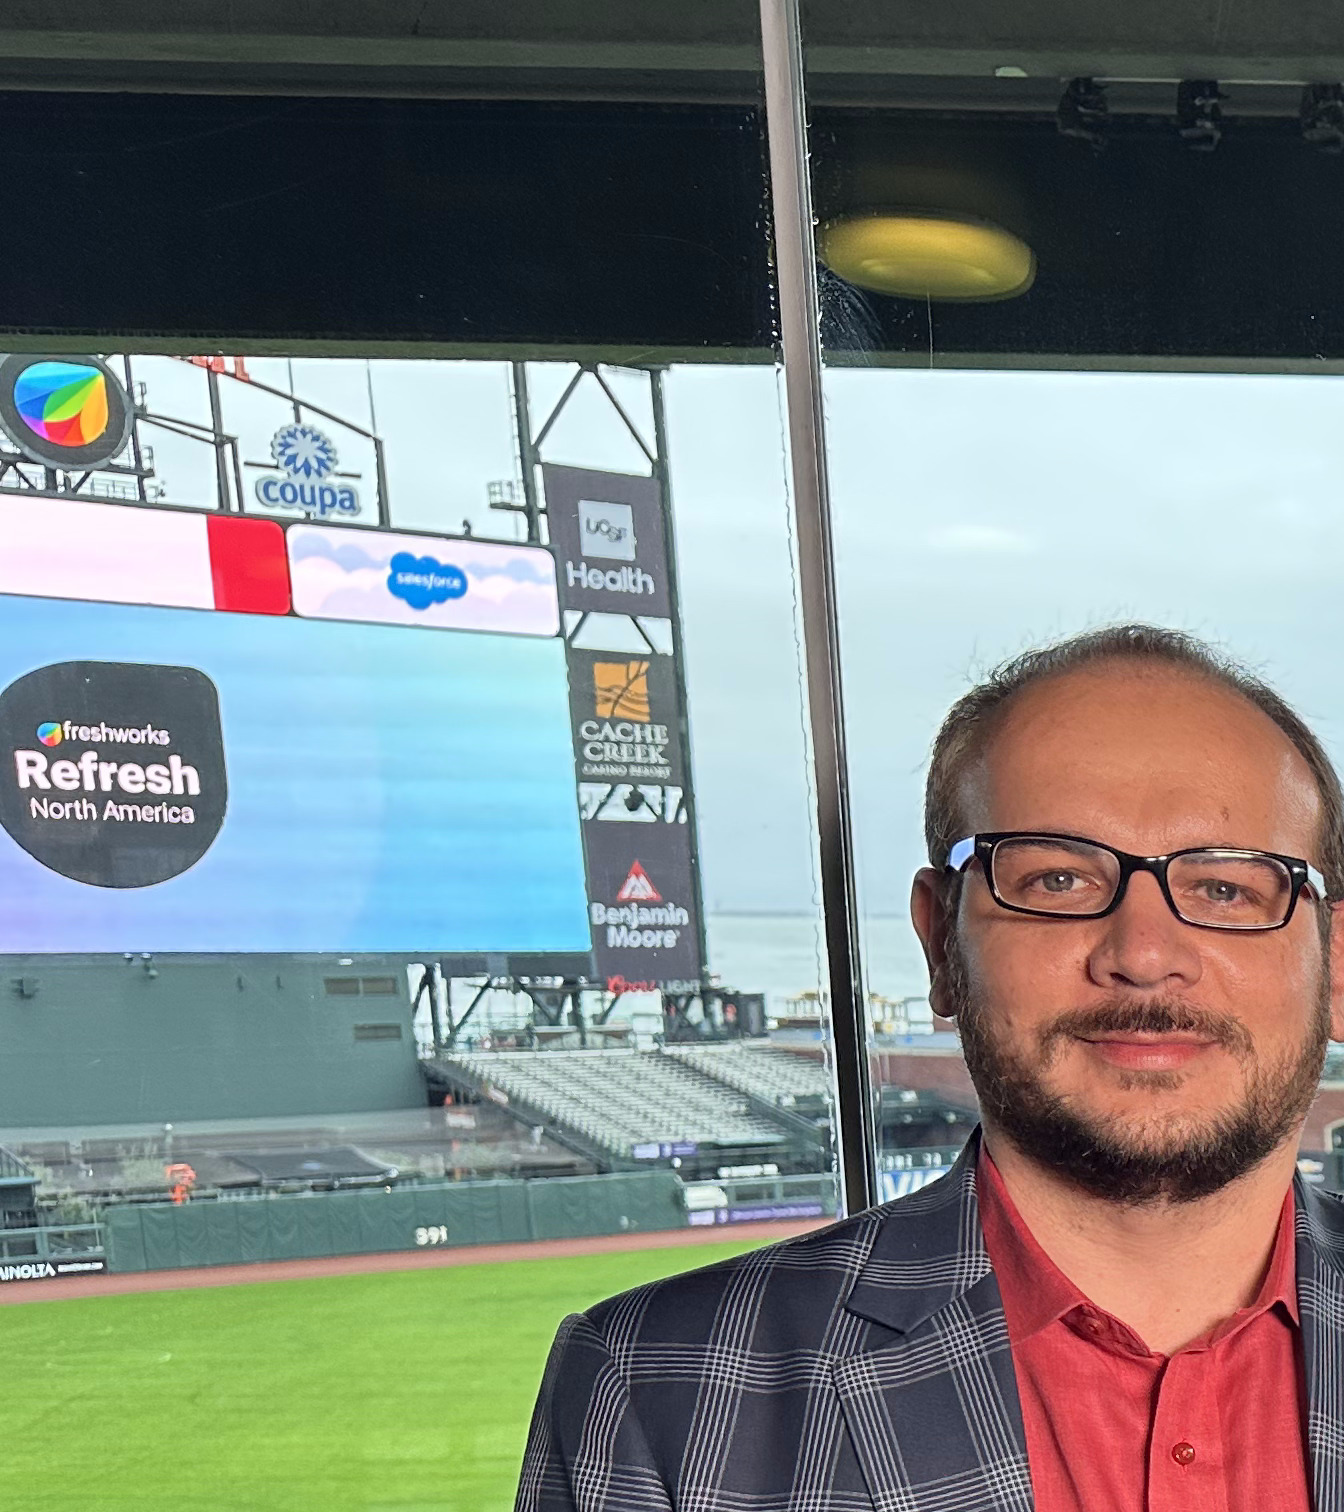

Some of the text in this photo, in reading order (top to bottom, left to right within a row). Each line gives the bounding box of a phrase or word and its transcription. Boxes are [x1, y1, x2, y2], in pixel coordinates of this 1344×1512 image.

[263, 479, 356, 515] coupa
[396, 571, 461, 590] salesforce
[566, 560, 655, 595] Health
[62, 720, 171, 746] freshworks
[581, 720, 669, 745] CACHE
[583, 741, 670, 765] CREEK
[14, 749, 201, 796] Refresh
[30, 797, 195, 824] North America
[591, 902, 689, 929] Benjamin
[607, 925, 678, 948] Moore
